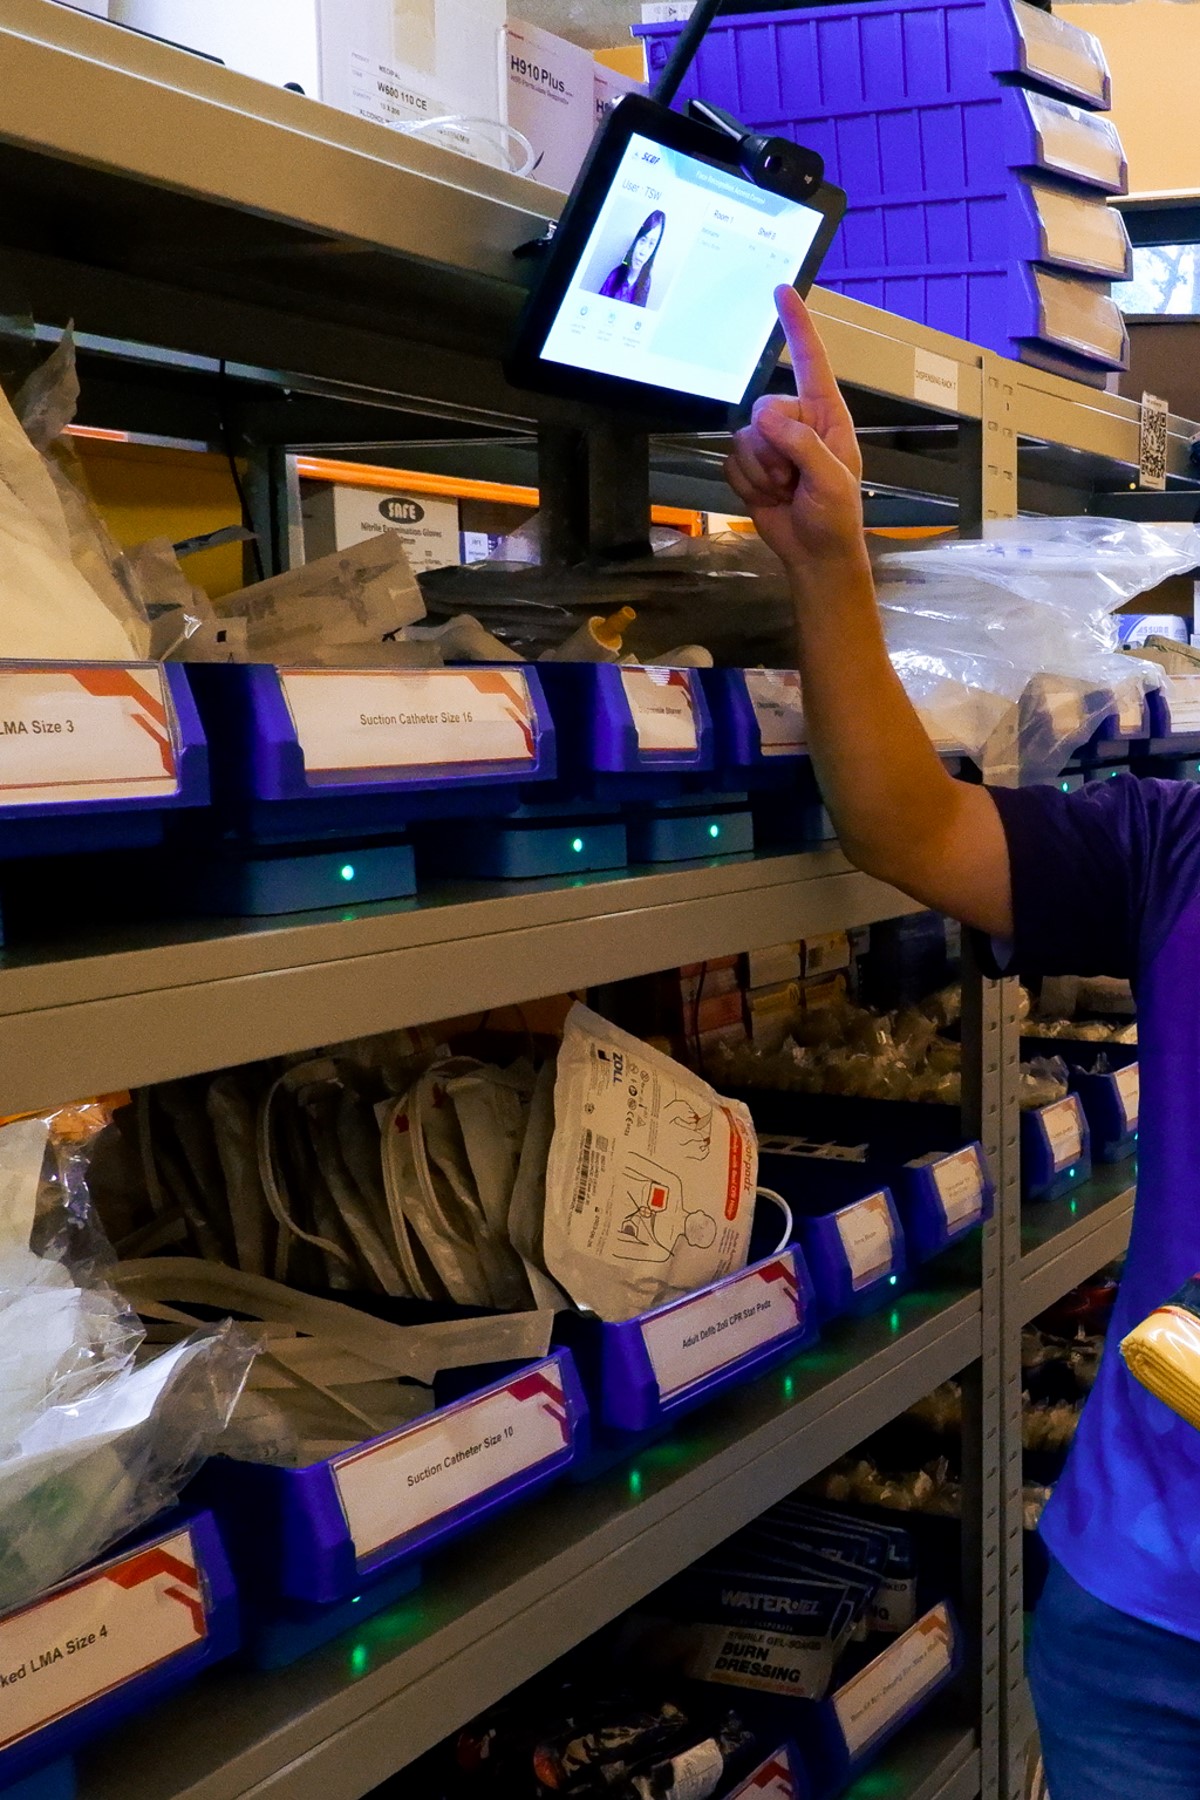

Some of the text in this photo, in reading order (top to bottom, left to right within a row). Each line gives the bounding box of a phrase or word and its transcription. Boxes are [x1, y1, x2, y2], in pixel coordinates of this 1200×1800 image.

[511, 55, 540, 81] H910
[541, 68, 565, 93] Plus
[415, 97, 428, 111] CE
[388, 502, 416, 520] SAFE
[361, 521, 382, 533] Nitrile
[31, 720, 62, 734] Size
[66, 719, 75, 733] 3
[360, 712, 473, 726] Suction Catheter Size 16
[612, 1052, 623, 1084] ZOLL
[729, 1312, 742, 1326] CPR
[407, 1426, 514, 1487] Suction Catheter Size 10
[30, 1647, 64, 1672] LMA
[65, 1633, 96, 1655] Size
[99, 1624, 108, 1638] 4
[720, 1641, 770, 1662] BURN
[714, 1657, 801, 1684] DRESSING
